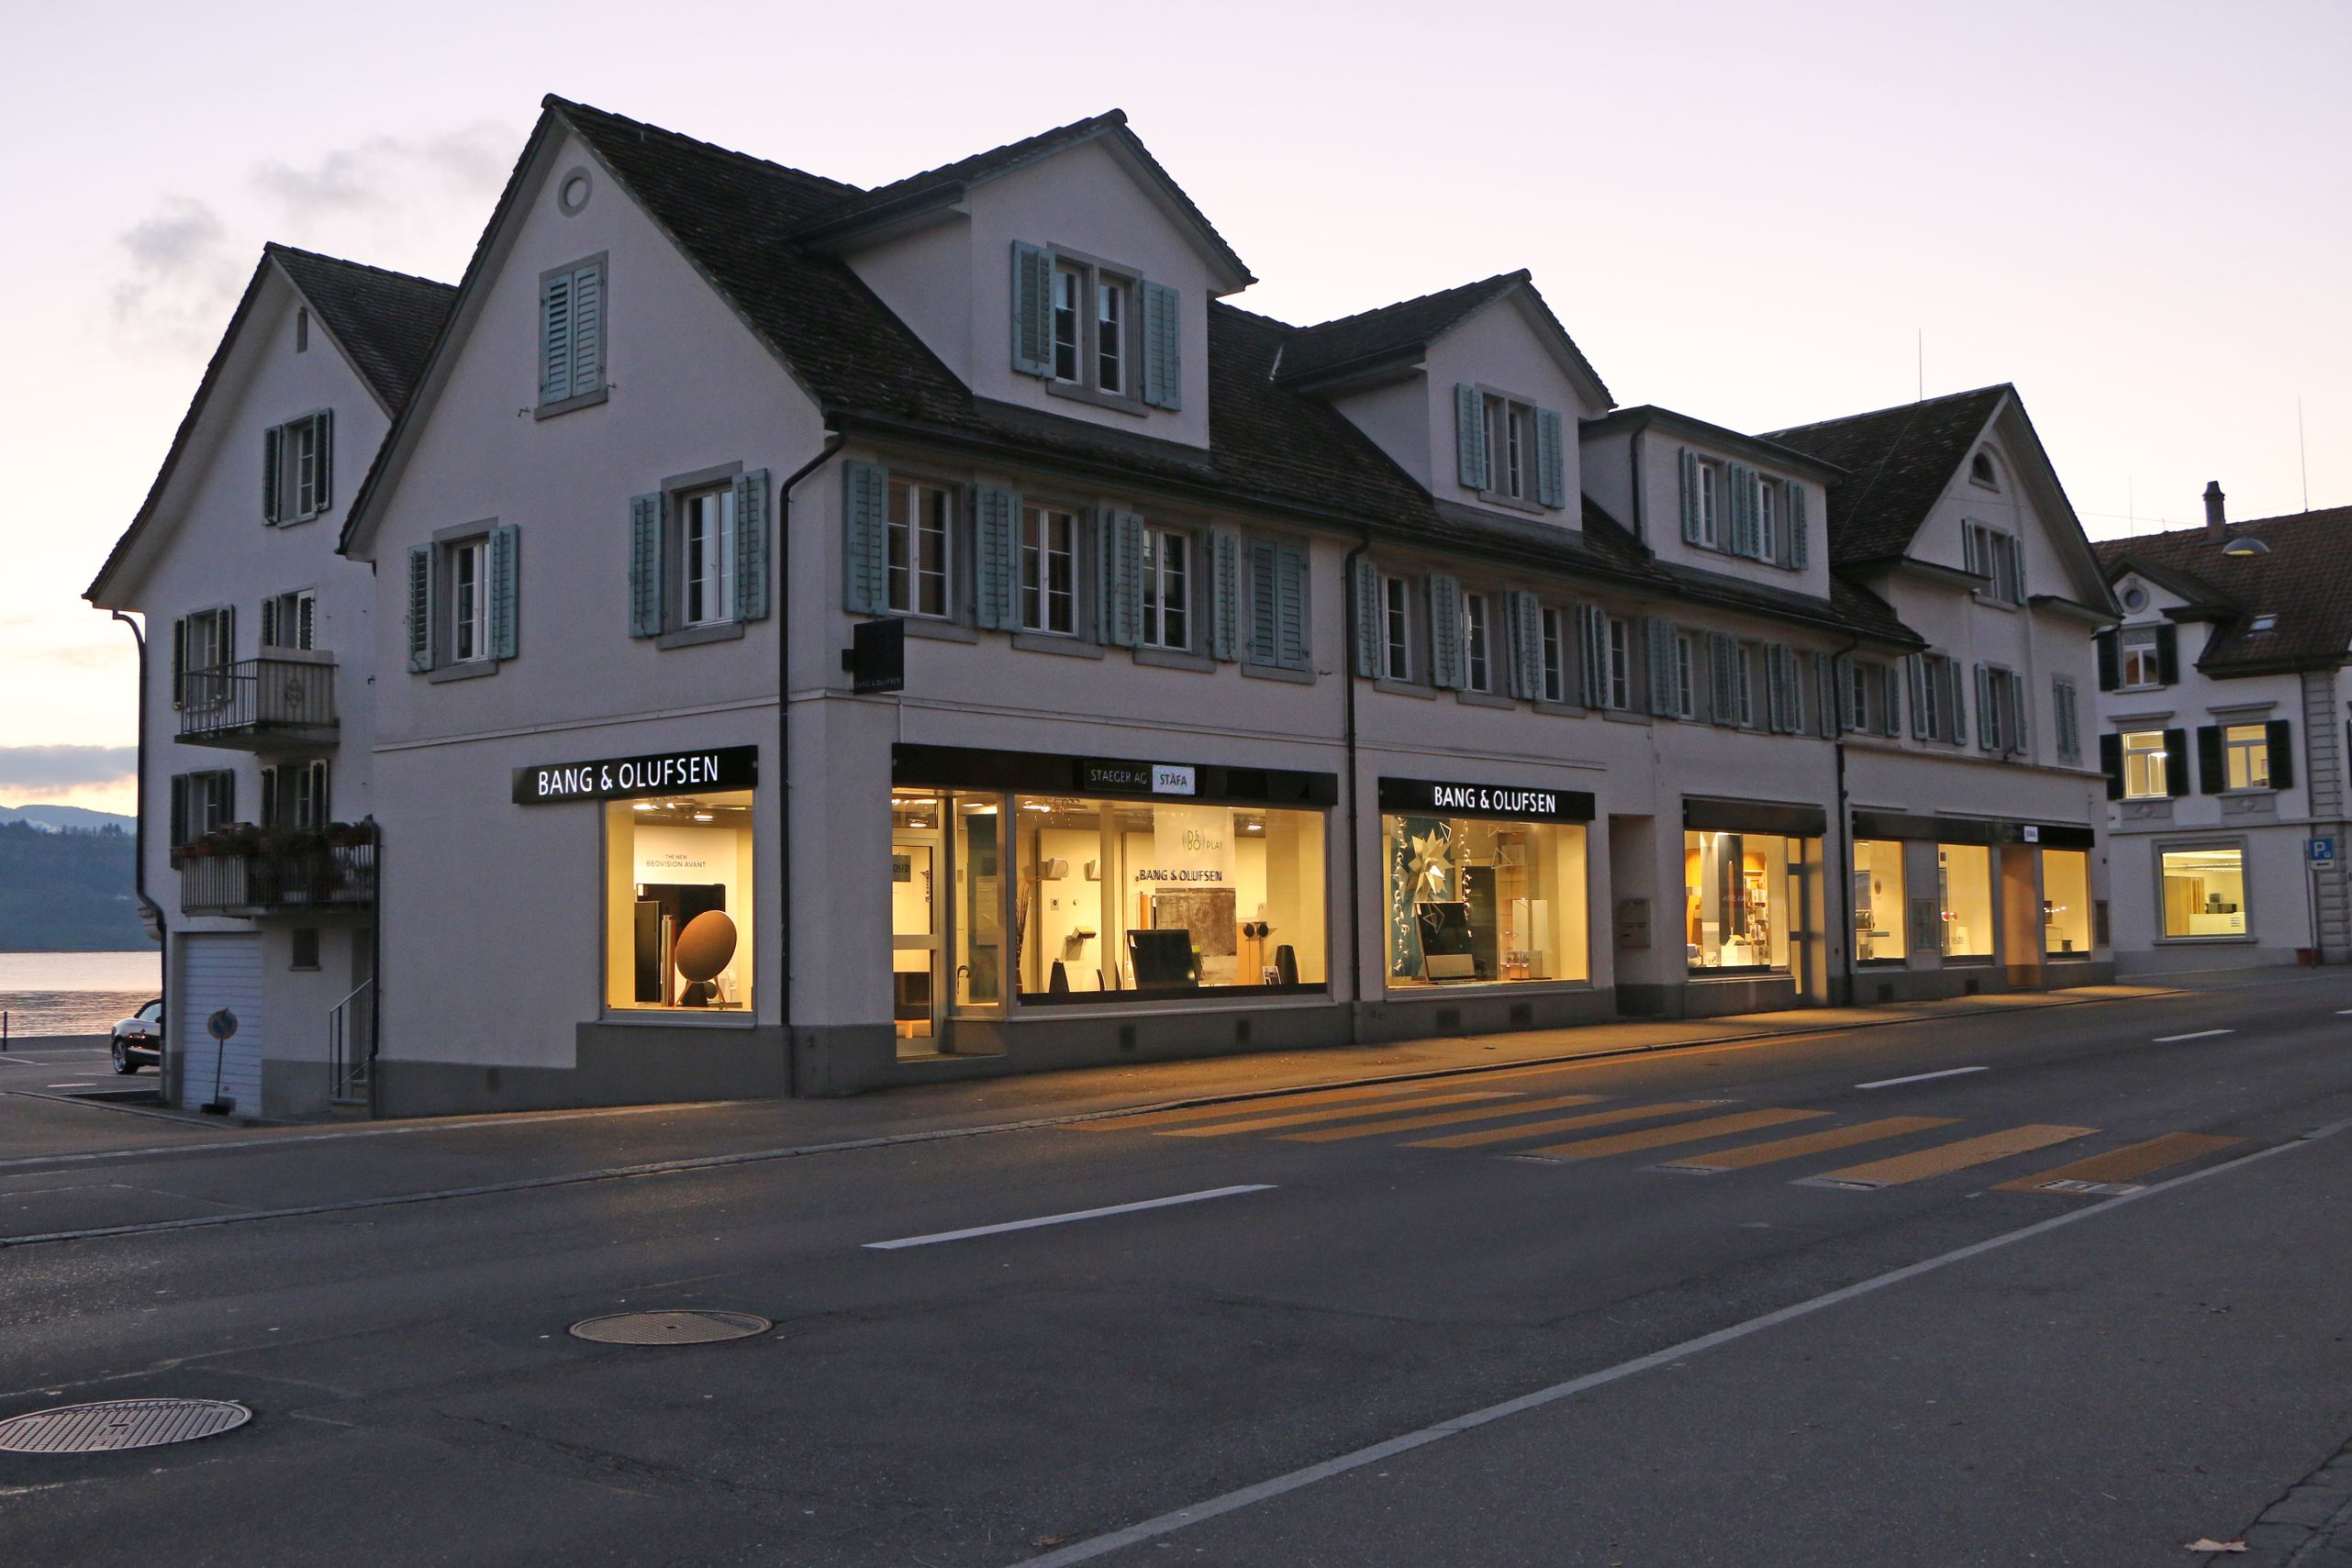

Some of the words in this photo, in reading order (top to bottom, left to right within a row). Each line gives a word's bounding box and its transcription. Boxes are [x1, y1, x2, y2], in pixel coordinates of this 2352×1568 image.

[538, 766, 593, 795] BANG
[600, 765, 613, 791] &
[619, 755, 718, 789] OLUFSEN
[1090, 769, 1131, 783] STAEGER
[1133, 772, 1147, 784] AG
[1159, 772, 1187, 786] STÄFA
[1434, 786, 1475, 808] BANG
[1480, 789, 1490, 809] &
[1493, 790, 1555, 813] OLUFSEN
[1207, 840, 1223, 851] PLAY
[2313, 841, 2325, 857] P
[646, 860, 683, 868] BEOVISION
[893, 864, 910, 873] OSED
[1139, 869, 1168, 881] BANG
[1170, 870, 1177, 881] &
[1178, 870, 1222, 882] OLUFSEN
